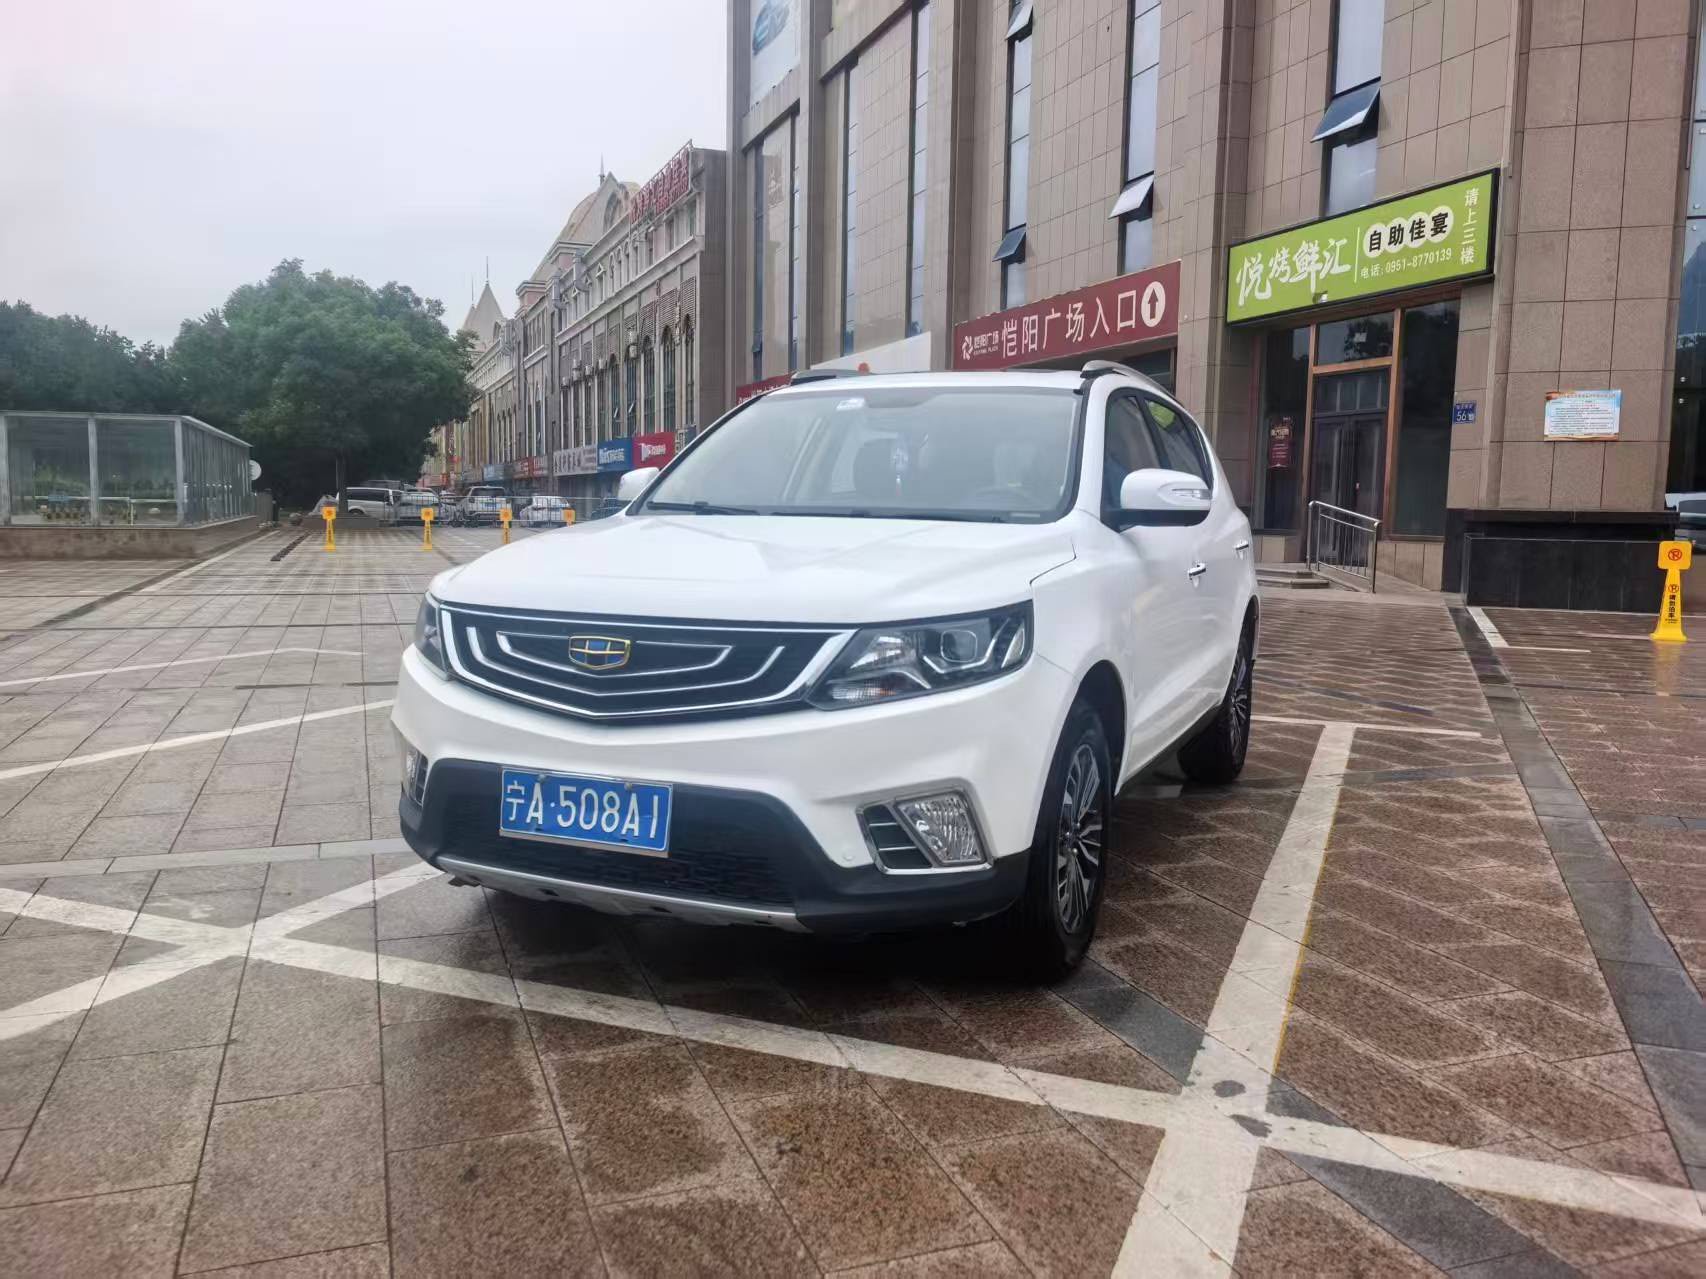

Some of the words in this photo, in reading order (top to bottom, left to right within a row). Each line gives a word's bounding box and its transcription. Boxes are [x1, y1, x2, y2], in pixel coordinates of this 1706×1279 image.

[1368, 211, 1450, 253] 自助佳宴
[1460, 187, 1480, 265] 请上三楼
[1236, 237, 1352, 306] 悦烤鲜汇
[1001, 289, 1137, 359] 恺阳广场入口
